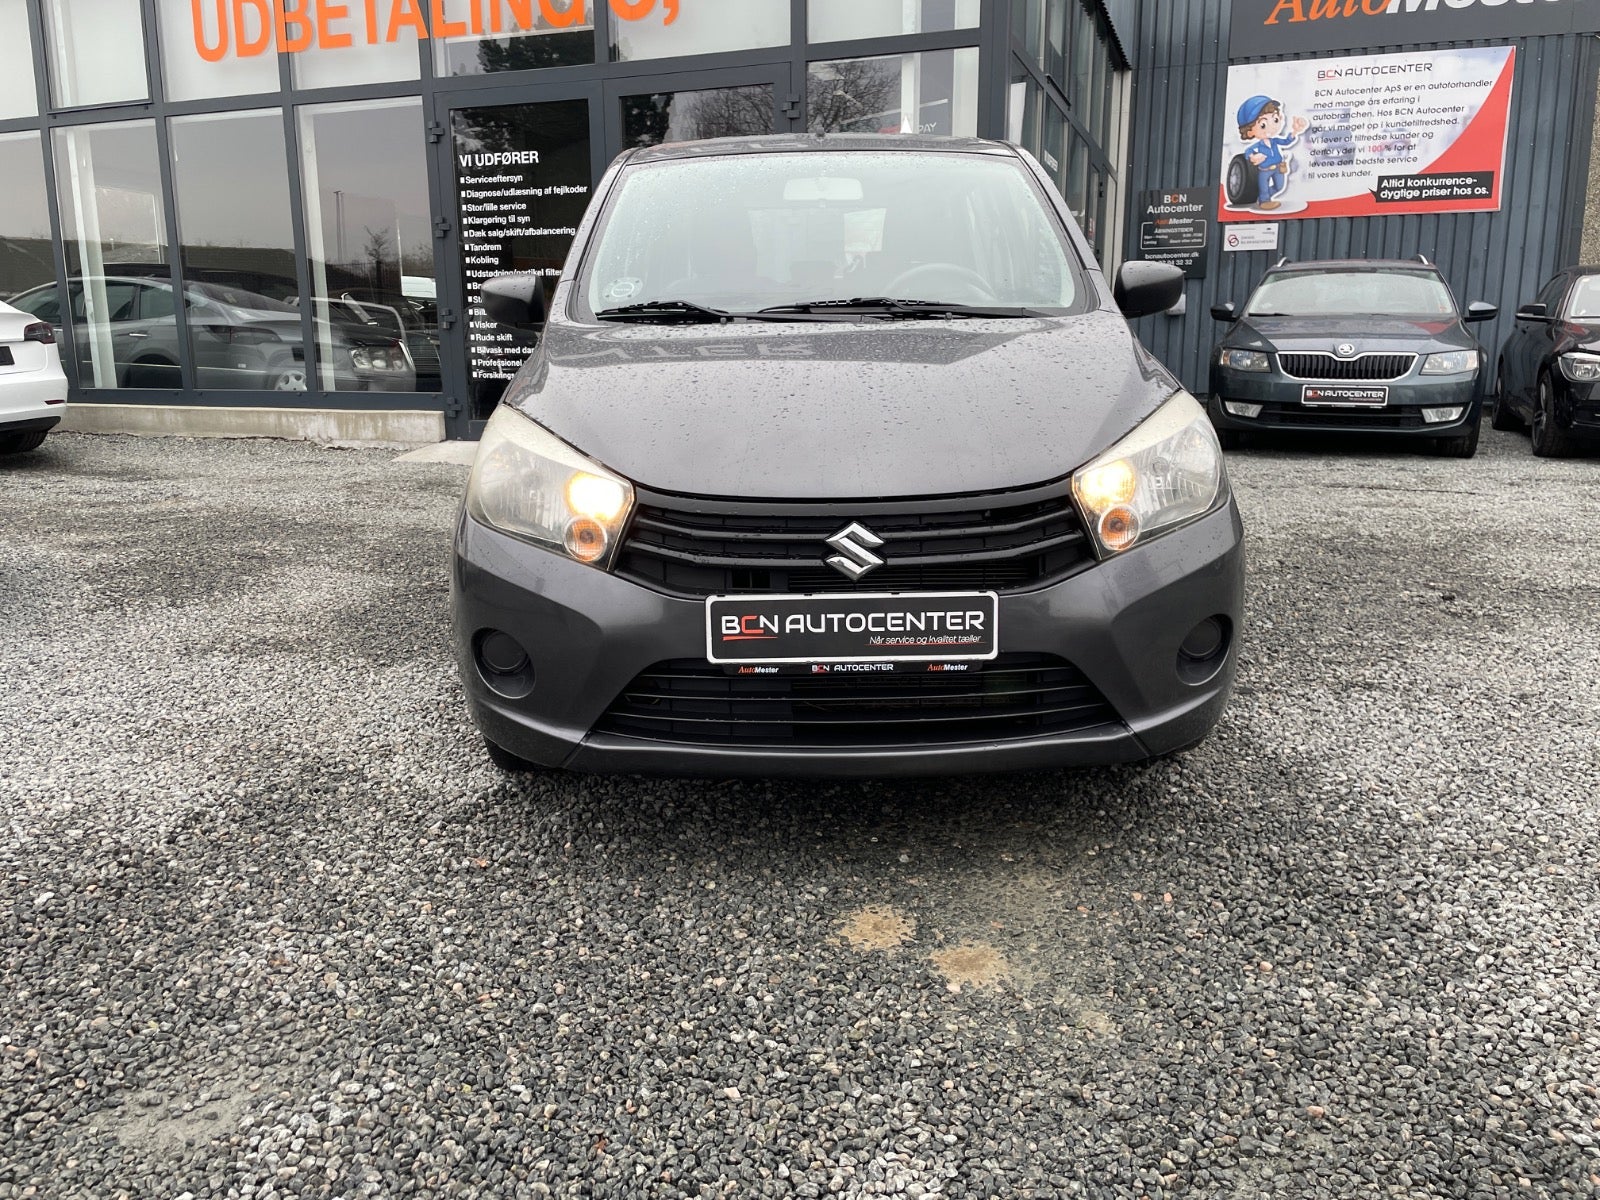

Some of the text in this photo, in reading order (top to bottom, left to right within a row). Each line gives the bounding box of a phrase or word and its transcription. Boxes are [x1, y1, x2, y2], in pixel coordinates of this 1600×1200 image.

[1317, 62, 1433, 79] BCN AUTOCENTER
[1315, 89, 1333, 98] BCN
[1335, 86, 1383, 96] Autocenter
[1384, 85, 1402, 95] ApS
[1428, 80, 1493, 90] autoforhandler
[1313, 100, 1333, 109] med
[1335, 100, 1366, 109] mange
[1368, 97, 1380, 106] års
[1382, 96, 1416, 106] erfaring
[1313, 106, 1465, 121] autobranchen. Hos BCN Autocenter
[1311, 125, 1326, 135] går
[1337, 123, 1365, 133] meget
[1367, 123, 1379, 131] op
[1385, 117, 1460, 128] kundetilfredshed.
[1355, 133, 1387, 142] tilfredse
[1390, 131, 1420, 140] kunder
[1422, 131, 1434, 140] og
[459, 151, 540, 167] VI UDFØRER
[1309, 160, 1335, 168] levere
[1356, 157, 1385, 165] bedste
[1341, 170, 1373, 178] kunder.
[465, 175, 523, 184] Serviceeftersyn
[1381, 177, 1477, 188] Altid konkurrence-
[466, 185, 588, 199] Diagnose/udlæsning af fejlkoder
[1380, 186, 1489, 199] dygtige priser hos os.
[1163, 194, 1187, 203] BCN
[467, 202, 527, 212] Stor/lille service
[1147, 204, 1204, 214] Autocenter
[508, 215, 516, 223] til
[517, 216, 531, 224] syn
[468, 226, 576, 239] Dæk salg/skift/afbalancering
[470, 243, 502, 252] Tandrem
[470, 256, 499, 265] Kobling
[1145, 251, 1200, 260] bcnautocenter.dk
[545, 268, 563, 276] filter
[474, 321, 498, 329] Visker
[475, 333, 513, 341] Rude skift
[476, 346, 503, 354] Bilvask
[504, 346, 521, 354] med
[477, 359, 523, 367] Professionel
[1325, 390, 1384, 398] AUTOCENTER
[721, 611, 985, 635] BCN AUTOCENTER
[869, 635, 981, 645] Når service og kvalitet tæller
[738, 666, 779, 674] AutoMester
[811, 663, 894, 673] BCN AUTOCENTER
[927, 664, 968, 672] AutoMester
